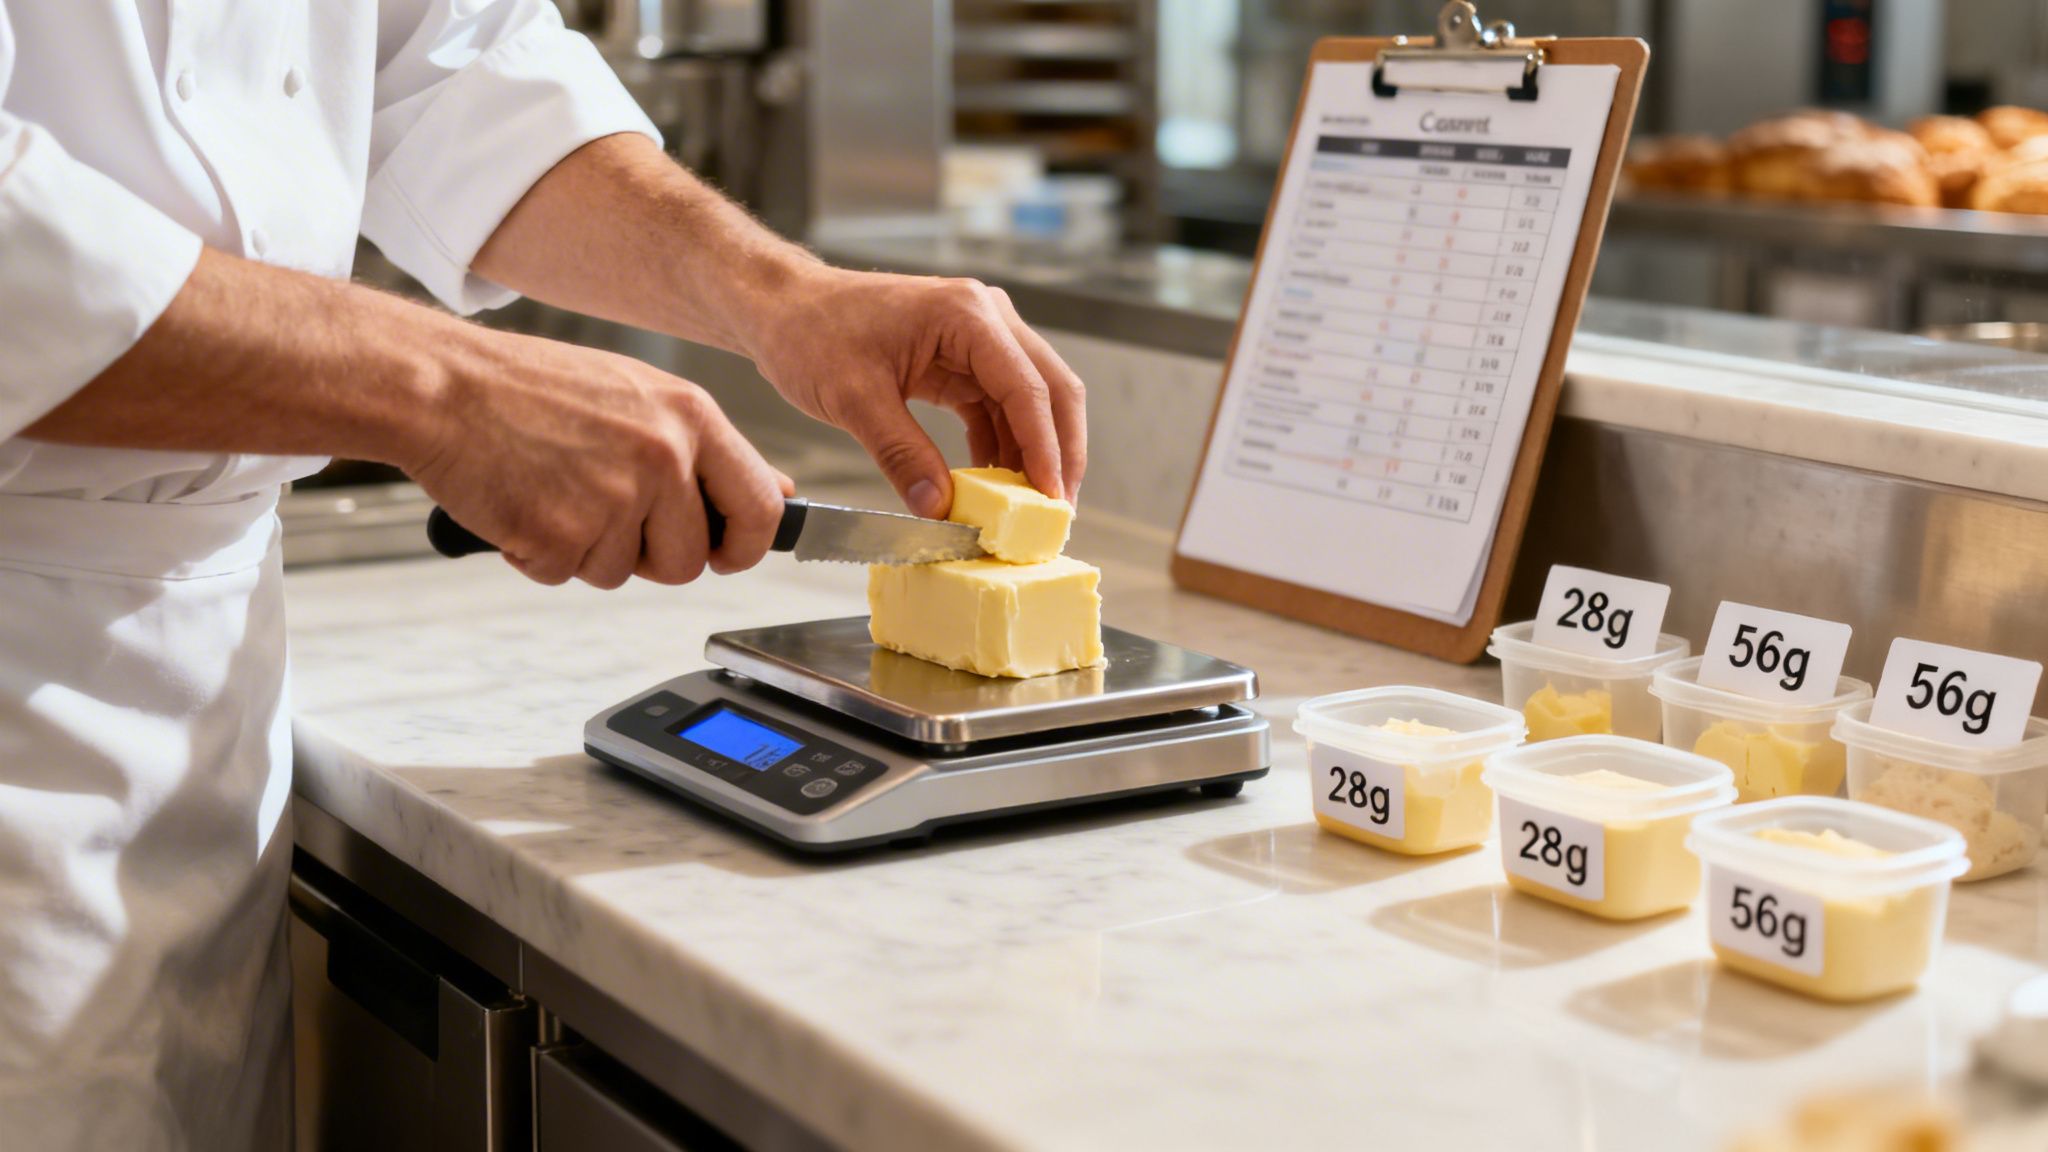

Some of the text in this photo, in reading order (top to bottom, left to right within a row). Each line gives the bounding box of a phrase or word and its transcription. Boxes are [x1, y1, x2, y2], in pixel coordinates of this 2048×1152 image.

[1556, 587, 1634, 649] 28g
[1728, 623, 1811, 692] 56g
[1906, 662, 1997, 735] 56g
[1328, 766, 1390, 825] 28g
[1519, 820, 1588, 887] 28g
[1731, 886, 1807, 958] 56g
